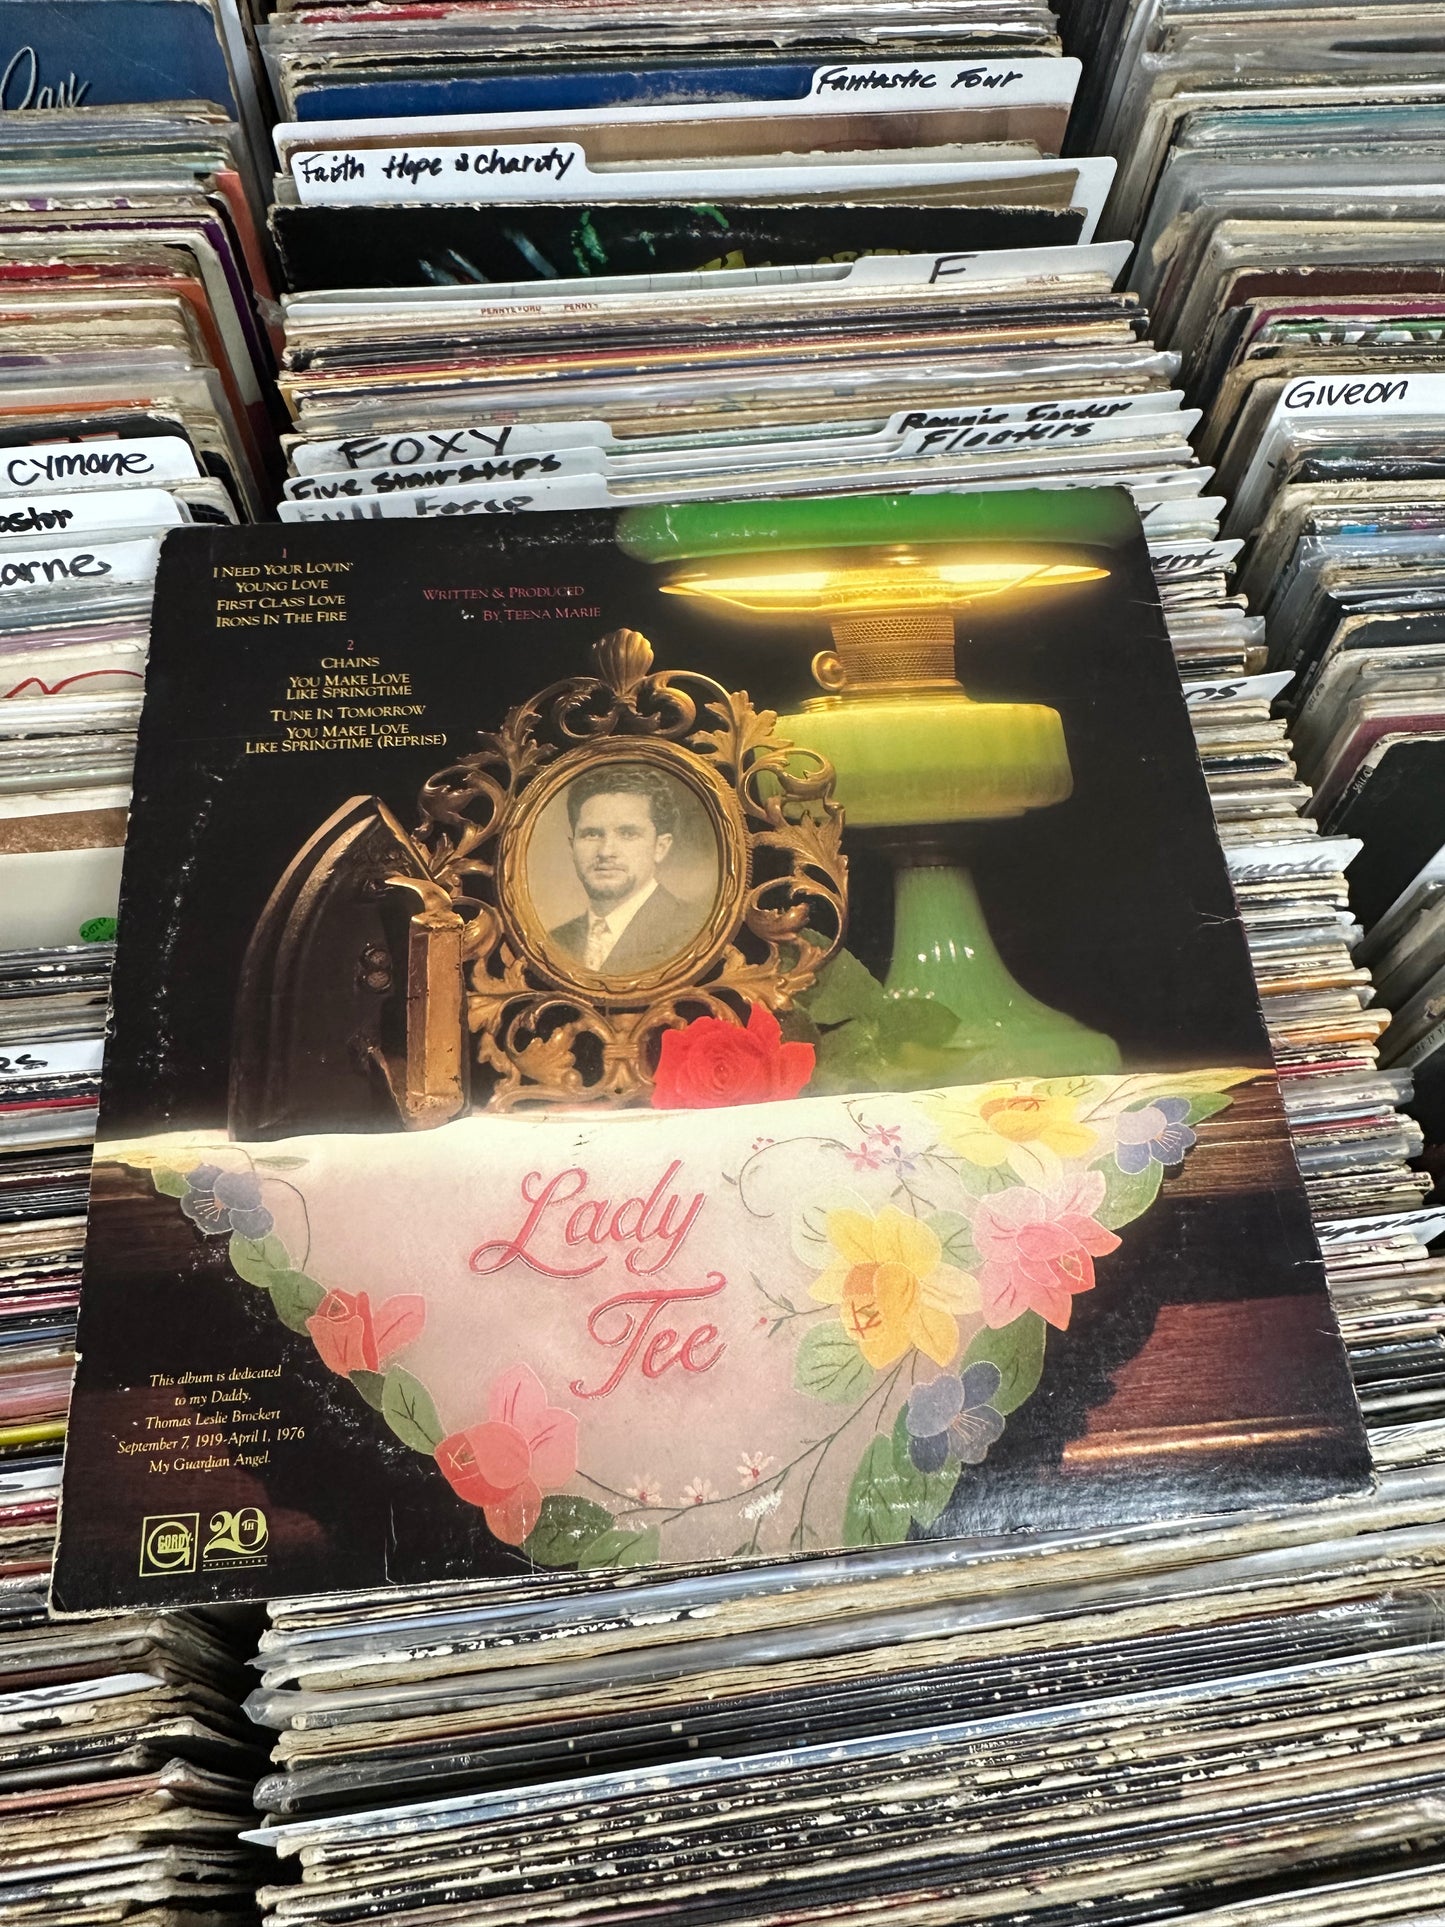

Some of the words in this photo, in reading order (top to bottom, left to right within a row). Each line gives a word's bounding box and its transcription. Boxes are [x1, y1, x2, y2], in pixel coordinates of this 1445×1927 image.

[816, 67, 937, 94] Fantastic
[299, 153, 364, 183] Faith
[382, 153, 443, 184] Hope
[929, 254, 979, 283] F
[1285, 380, 1408, 408] Giveon
[338, 427, 512, 468] FOXY
[916, 422, 1095, 453] Floaters
[291, 478, 362, 501] Five
[371, 454, 562, 494] Stairsteps
[0, 507, 74, 533] astor
[0, 554, 112, 589] arne
[213, 567, 218, 579] I
[222, 566, 261, 578] NEED
[263, 564, 303, 576] YOUR
[236, 582, 288, 593] YOUNG
[292, 579, 329, 591] LOVE
[423, 588, 489, 600] WRITTEN
[492, 588, 505, 599] &
[509, 586, 585, 598] PRODUCED
[217, 599, 257, 611] FIRST
[259, 597, 306, 609] CLASS
[309, 595, 346, 606] LOVE
[216, 616, 260, 628] IRONS
[263, 613, 280, 625] IN
[284, 612, 313, 625] THE
[317, 611, 347, 623] FIRE
[483, 610, 500, 622] BY
[504, 609, 551, 621] TEENA
[555, 607, 601, 619] MARIE
[347, 640, 354, 650] 2
[321, 657, 380, 669] CHAINS
[289, 676, 320, 688] YOU
[325, 674, 369, 687] MAKE
[372, 673, 410, 685] LOVE
[286, 688, 318, 700] LIKE
[322, 685, 412, 699] SPRINGTIME
[270, 709, 312, 722] TUNE
[316, 708, 333, 720] IN
[337, 705, 426, 719] TOMORROW
[286, 727, 318, 739] YOU
[322, 725, 366, 738] MAKE
[370, 723, 409, 735] LOVE
[245, 741, 278, 754] LIKE
[281, 737, 373, 752] SPRINGTIME
[377, 733, 447, 749] (REPRISE)
[469, 1159, 707, 1279] Lady
[569, 1271, 727, 1400] Tee
[150, 1373, 175, 1387] This
[177, 1371, 213, 1385] album
[216, 1371, 226, 1382] is
[228, 1365, 282, 1381] dedicated
[175, 1396, 187, 1406] to
[189, 1395, 207, 1407] my
[145, 1415, 192, 1430] Thomas
[195, 1411, 228, 1426] Leslie
[232, 1407, 281, 1423] Brockert
[117, 1437, 179, 1456] September
[182, 1436, 190, 1450] 7,
[277, 1426, 305, 1441] 1976
[149, 1460, 170, 1475] My
[173, 1455, 230, 1472] Guardian
